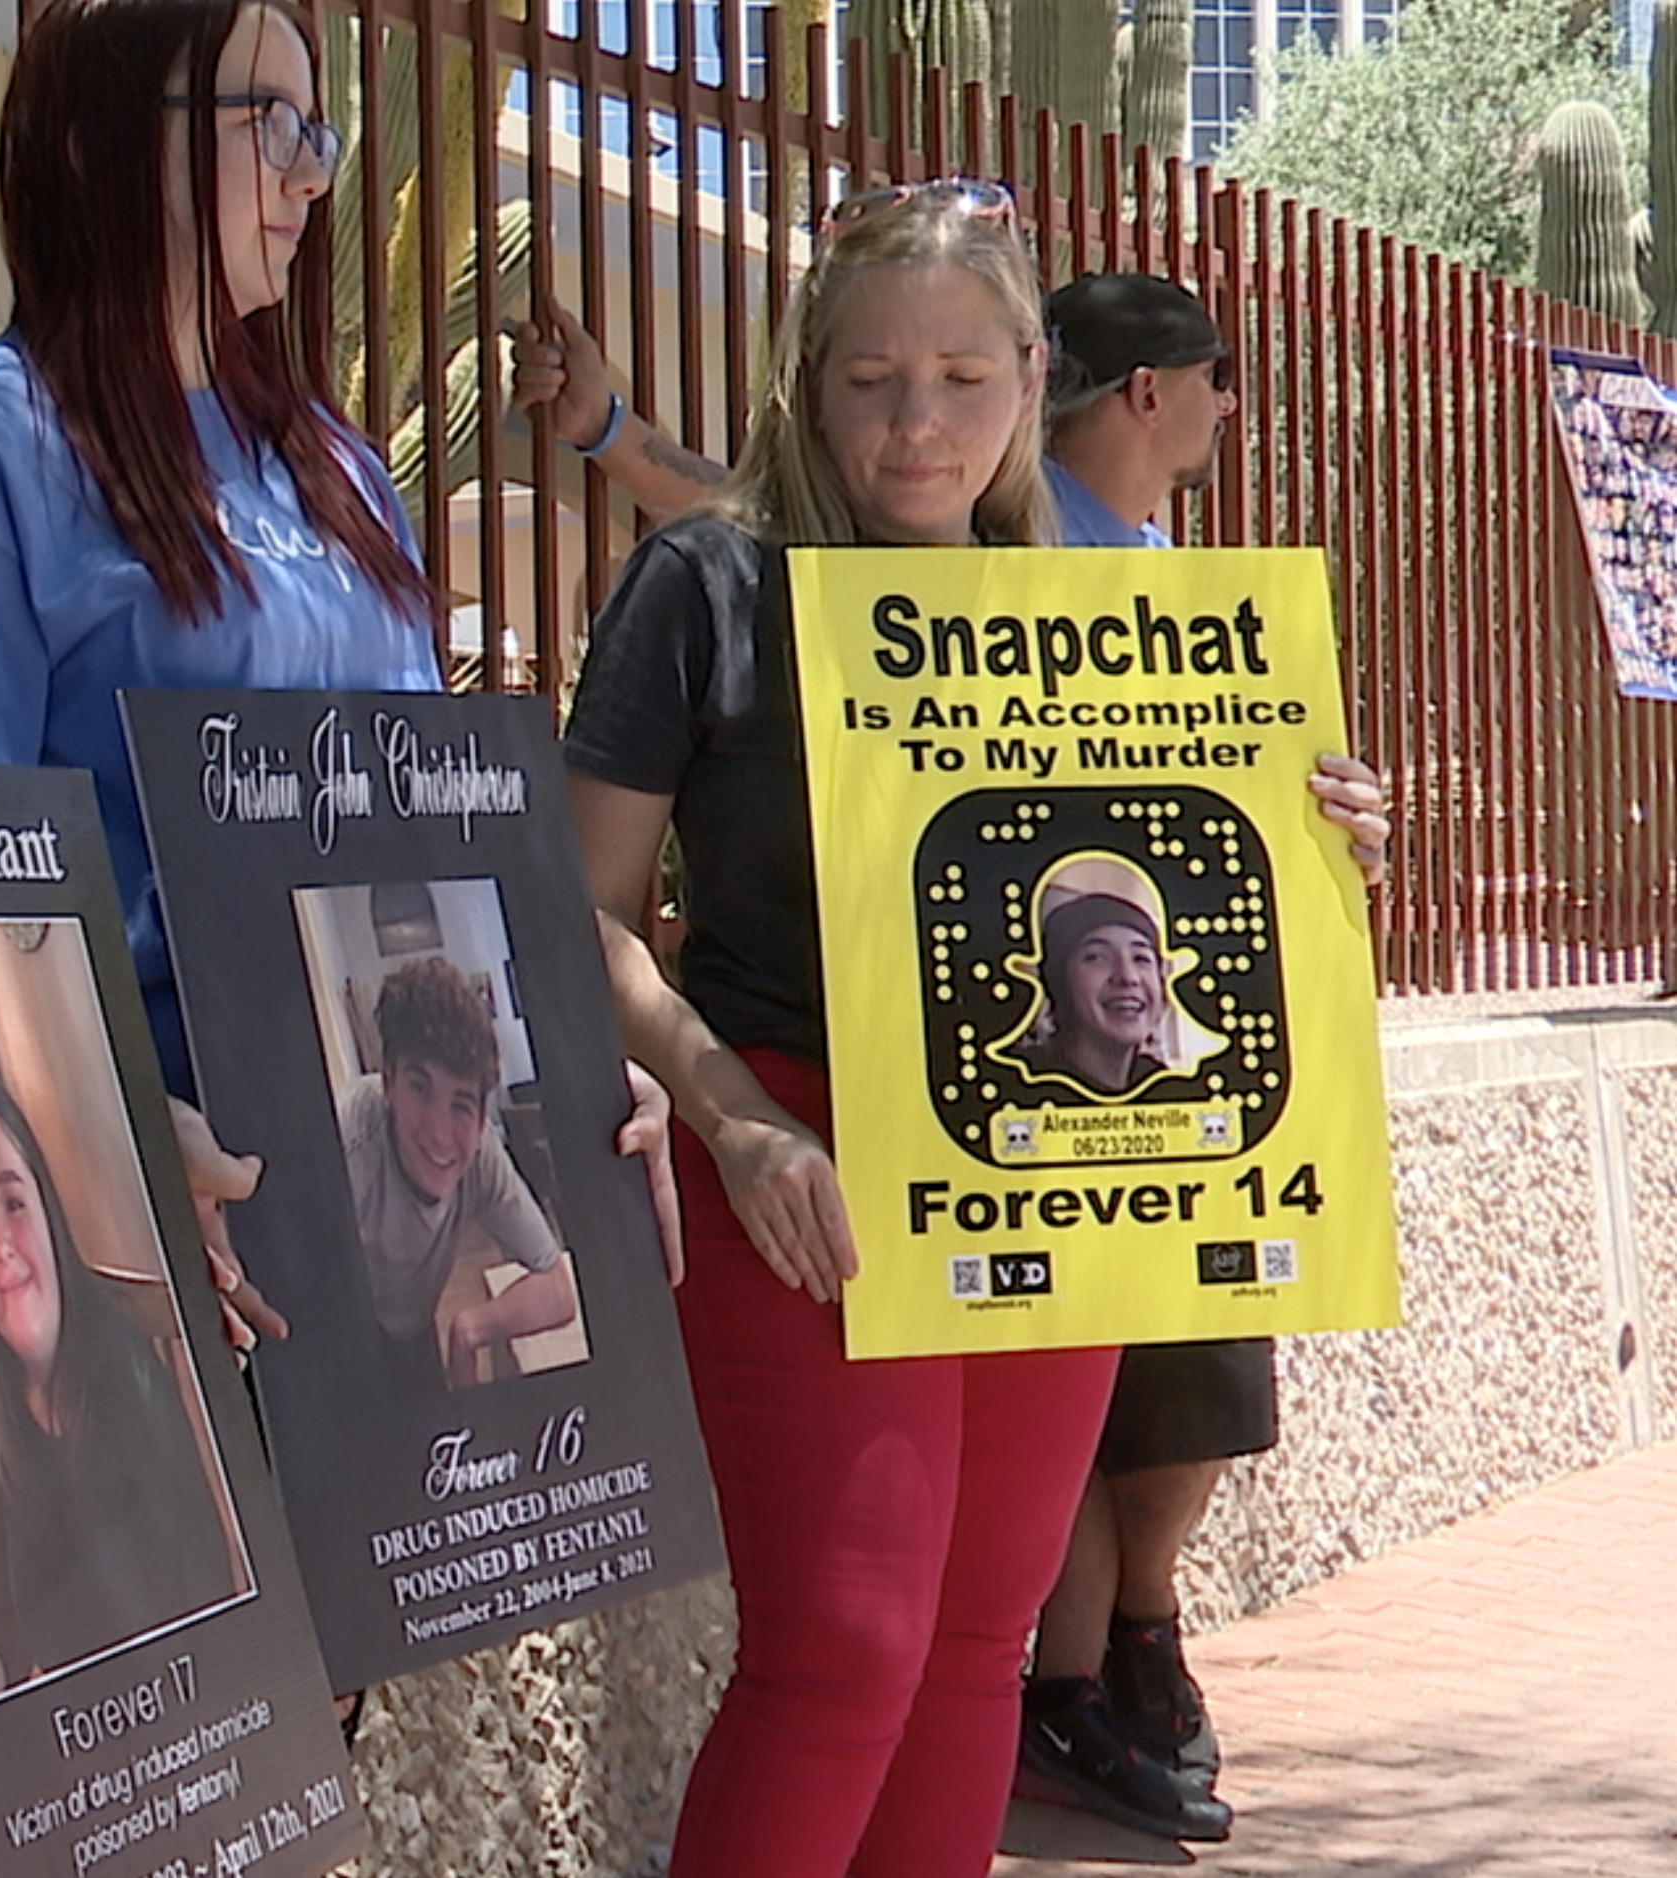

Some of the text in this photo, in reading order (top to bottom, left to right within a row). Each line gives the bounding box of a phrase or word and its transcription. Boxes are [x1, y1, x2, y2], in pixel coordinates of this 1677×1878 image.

[871, 593, 1269, 697] Snapchat
[843, 695, 1308, 732] Is An Accomplice
[900, 738, 1262, 777] To My Murder
[311, 706, 371, 856] John
[1042, 1107, 1190, 1133] Alexander Neville
[1073, 1135, 1164, 1158] 06/23/2020
[909, 1164, 1323, 1234] Forever 14
[424, 1406, 587, 1501] Forever 16
[372, 1461, 652, 1566] DRUG INDUCED HOMICIDE
[393, 1507, 649, 1607] POISONED BY FENTANYL
[403, 1600, 493, 1645] November
[618, 1548, 653, 1577] 2021
[54, 1655, 199, 1758] Forever 17
[6, 1699, 272, 1848] Victim of drug induced homicide
[72, 1758, 242, 1876] poisoned by fentanyl
[214, 1820, 262, 1878] April
[304, 1774, 346, 1827] 2021
